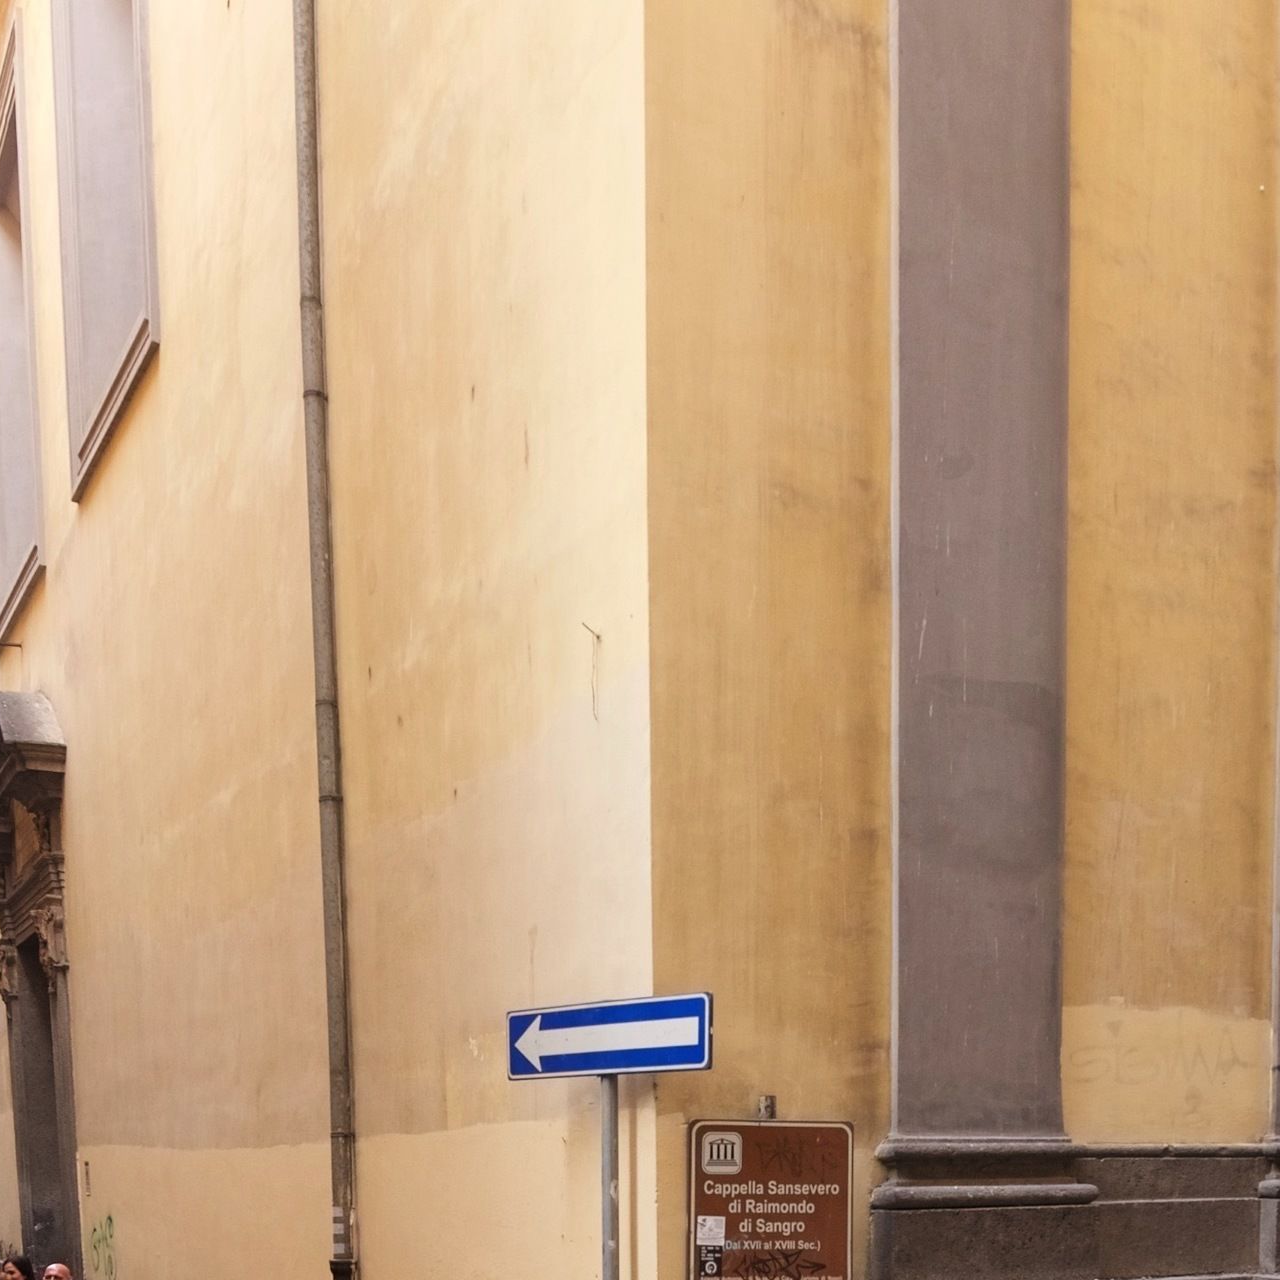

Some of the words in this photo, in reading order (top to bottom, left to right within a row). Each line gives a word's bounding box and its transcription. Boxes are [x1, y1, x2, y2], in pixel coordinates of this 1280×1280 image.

[704, 1180, 763, 1198] Cappella
[768, 1181, 839, 1195] Sansevero
[728, 1199, 741, 1214] di
[746, 1200, 815, 1214] Raimondo
[739, 1218, 752, 1233] di
[756, 1219, 805, 1236] Sangro
[742, 1240, 761, 1250] XVII
[763, 1240, 772, 1250] al
[774, 1240, 796, 1250] XVIII
[798, 1240, 820, 1252] Sec.)
